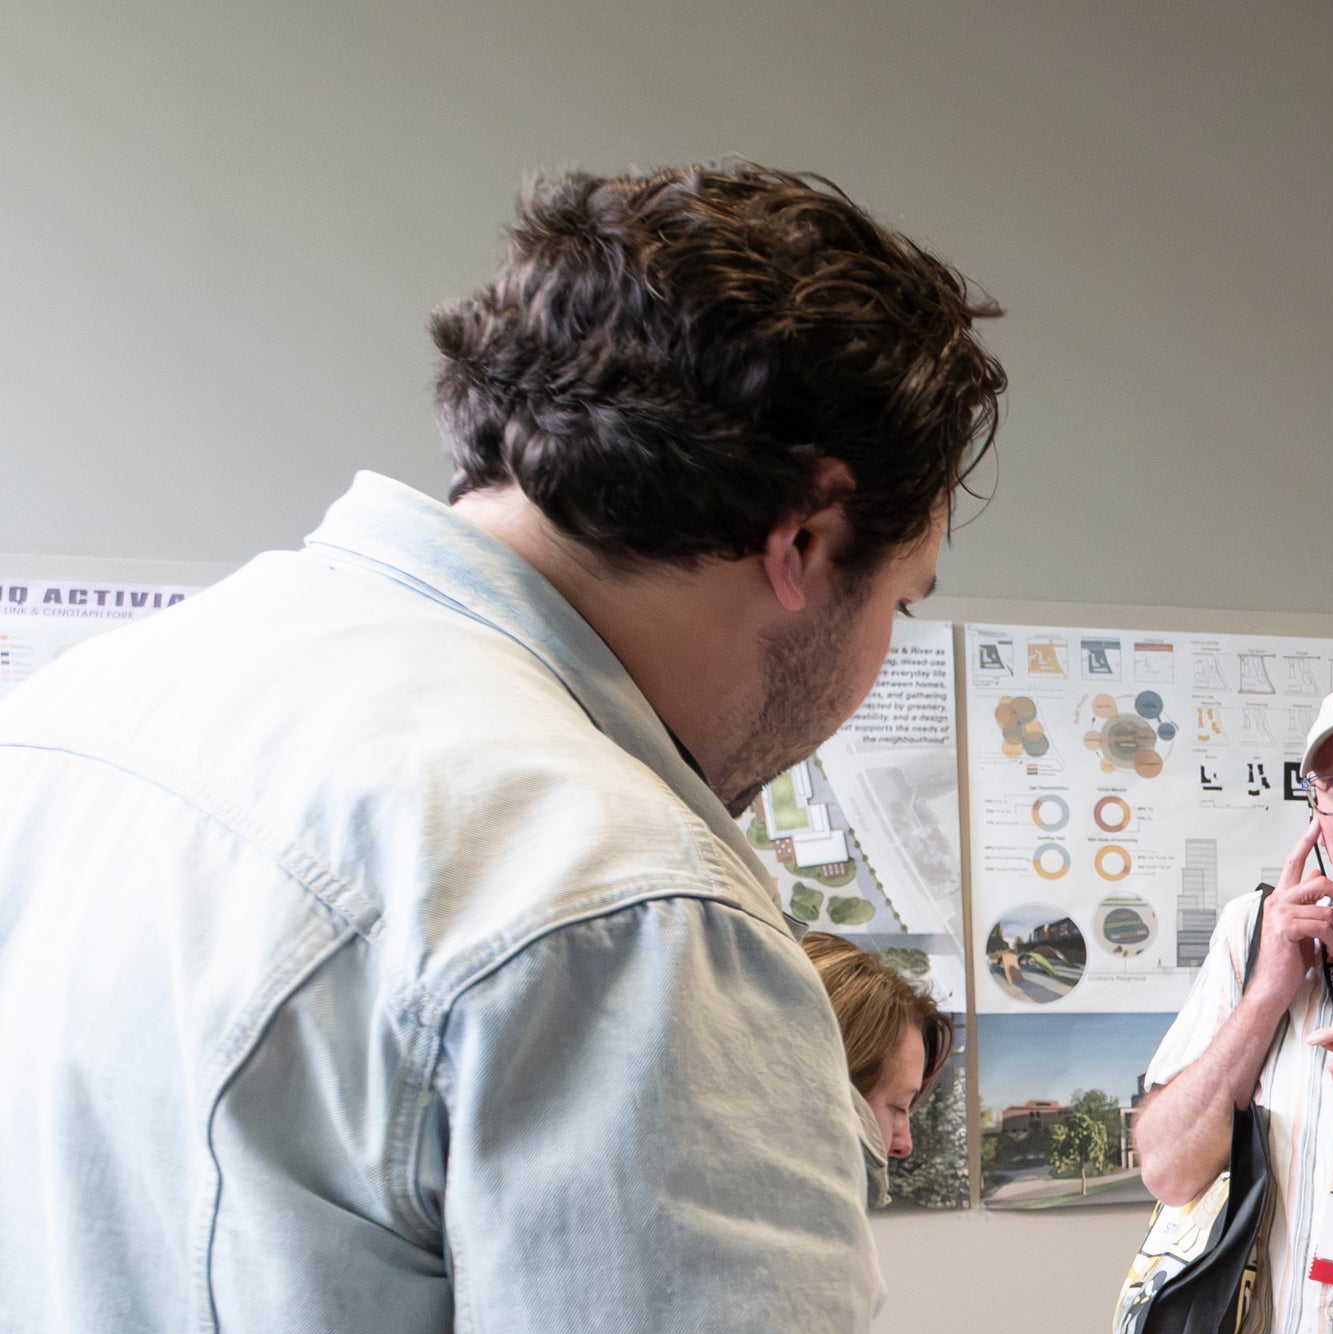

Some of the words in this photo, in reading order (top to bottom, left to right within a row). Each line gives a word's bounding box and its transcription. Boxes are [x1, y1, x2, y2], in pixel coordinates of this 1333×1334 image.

[4, 607, 27, 615] LINK
[30, 607, 39, 616] &
[106, 610, 135, 620] FORK
